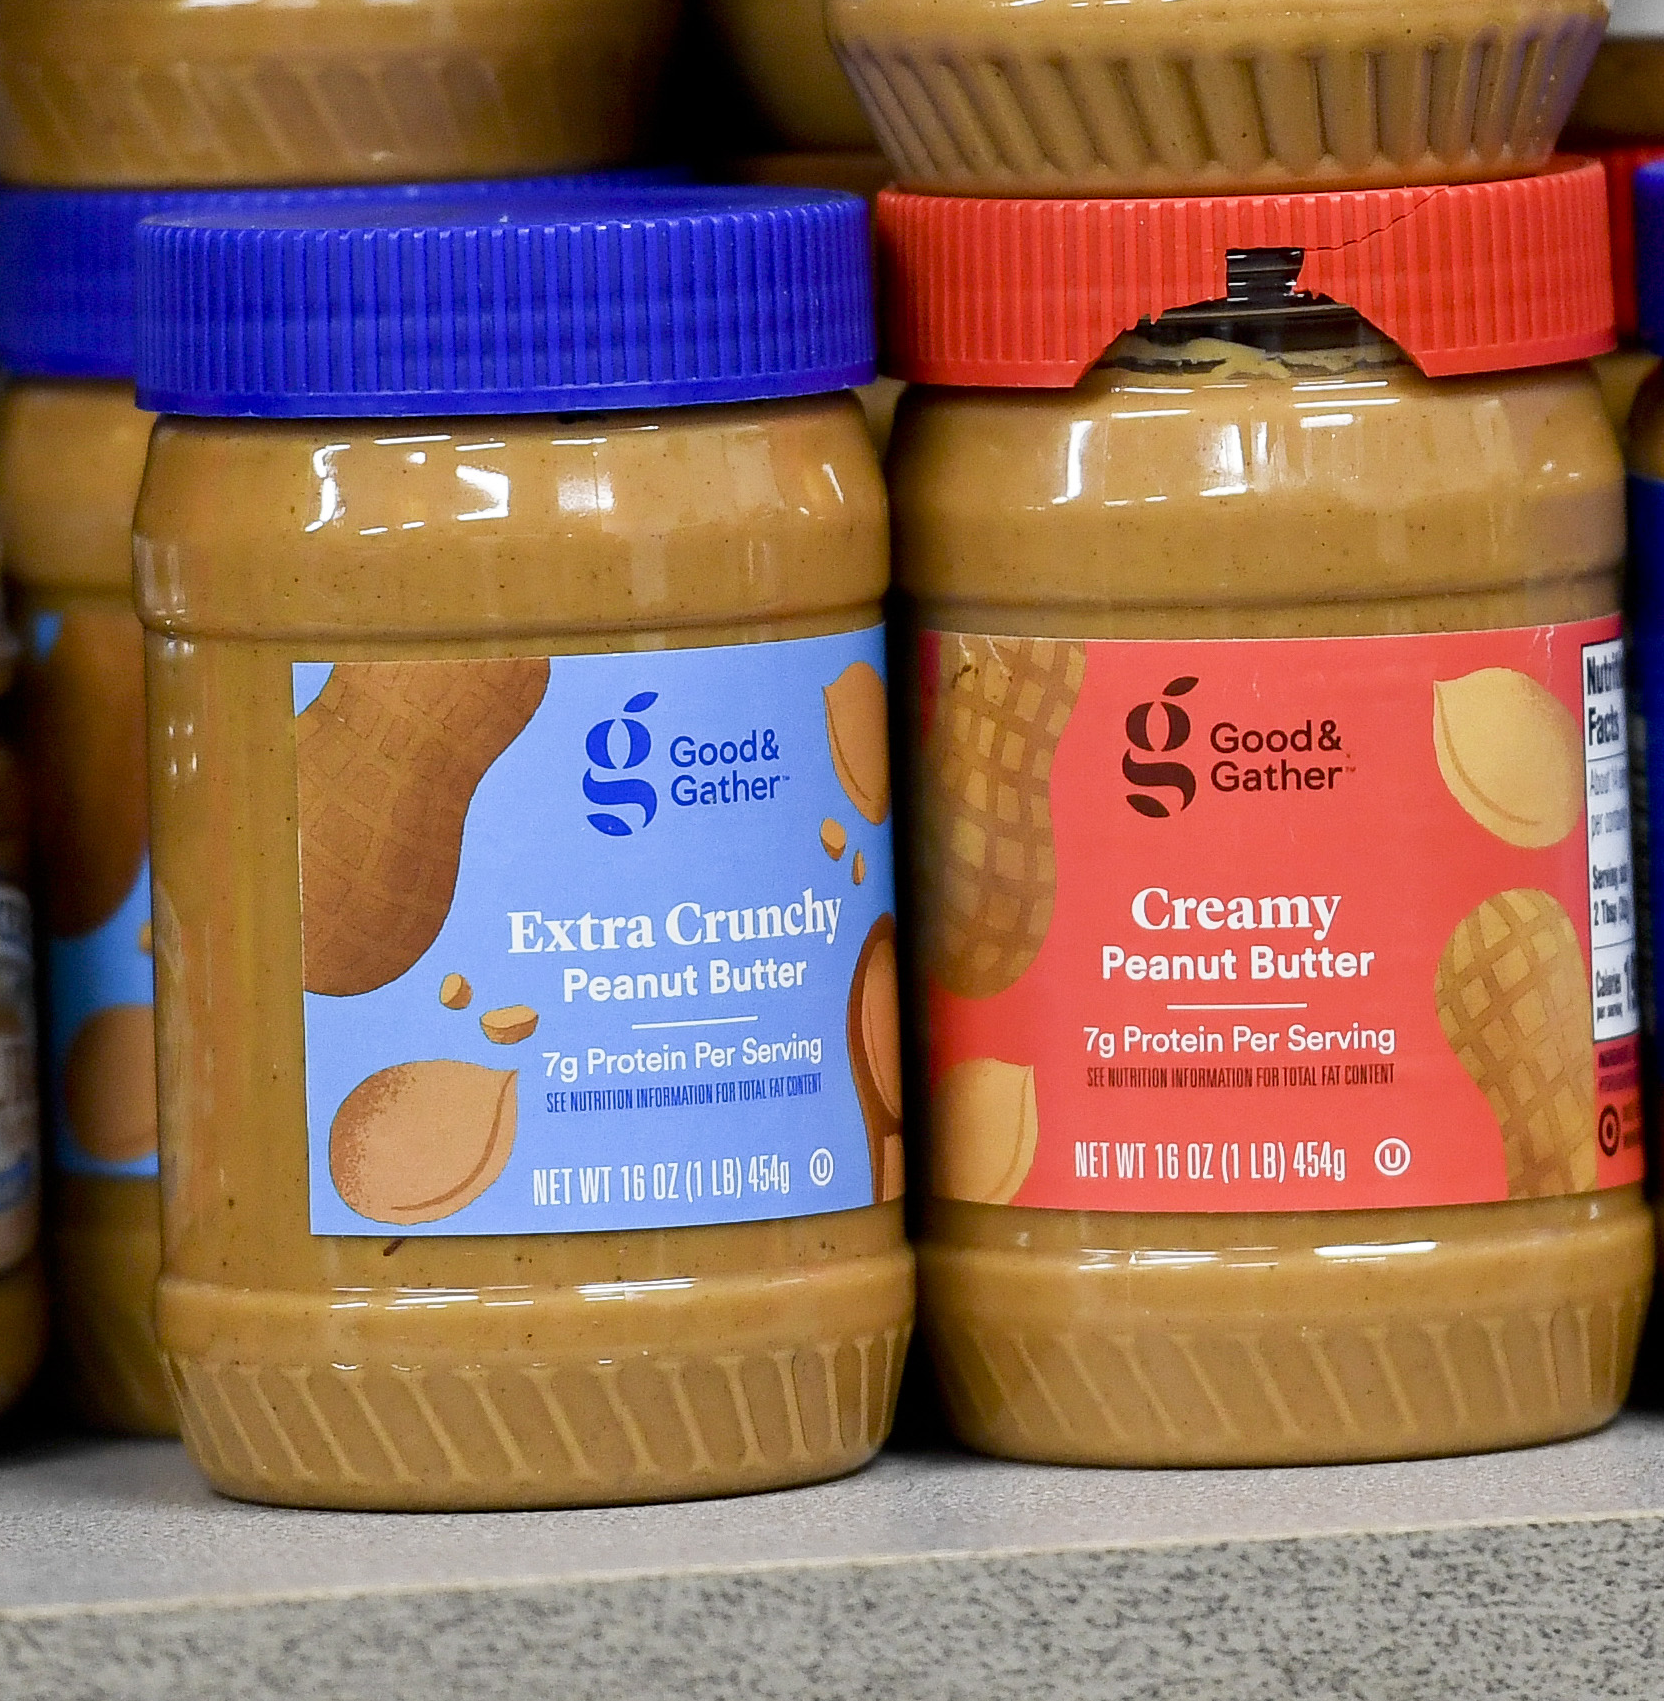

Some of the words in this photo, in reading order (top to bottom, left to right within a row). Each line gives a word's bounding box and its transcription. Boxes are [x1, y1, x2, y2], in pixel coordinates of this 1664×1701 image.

[669, 728, 780, 769] Good&
[1209, 719, 1342, 754] Good&
[507, 908, 656, 954] Extra
[665, 887, 842, 948] Crunchy
[1130, 886, 1342, 940] Creamy
[562, 961, 699, 1003] Peanut
[709, 956, 807, 995] Butter
[1101, 947, 1238, 981] Peanut
[1250, 947, 1375, 979] Butter
[543, 1052, 578, 1082] 7g
[588, 1044, 686, 1075] Protein
[695, 1041, 736, 1069] Per
[742, 1033, 822, 1065] Serving
[1083, 1027, 1116, 1058] 7g
[1124, 1025, 1224, 1053] Protein
[1233, 1025, 1279, 1052] Per
[1287, 1022, 1395, 1055] Serving
[546, 1092, 567, 1113] SEE
[571, 1089, 633, 1111] NUTRITION
[637, 1084, 713, 1109] INFORMATION
[716, 1082, 736, 1104] FOR
[739, 1080, 767, 1102] TOTAL
[769, 1077, 784, 1098] FAT
[787, 1072, 822, 1096] CONTENT
[1087, 1067, 1104, 1087] SEE
[1108, 1067, 1167, 1088] NUTRITION
[1172, 1067, 1253, 1088] INFORMATION
[1256, 1066, 1279, 1087] FOR
[1282, 1066, 1317, 1087] TOTAL
[1321, 1065, 1341, 1086] FAT
[1345, 1063, 1395, 1086] CONTENT
[532, 1168, 573, 1206] NET
[579, 1167, 612, 1204] WT
[621, 1164, 645, 1202] 16
[653, 1163, 679, 1200] OZ
[687, 1161, 702, 1203] (1
[712, 1157, 742, 1199] LB)
[748, 1154, 790, 1194] 454g
[1074, 1141, 1110, 1179] NET
[1115, 1142, 1146, 1179] WT
[1155, 1143, 1179, 1180] 16
[1188, 1143, 1214, 1180] OZ
[1221, 1142, 1240, 1184] (1
[1250, 1142, 1286, 1184] LB)
[1293, 1141, 1346, 1181] 454g
